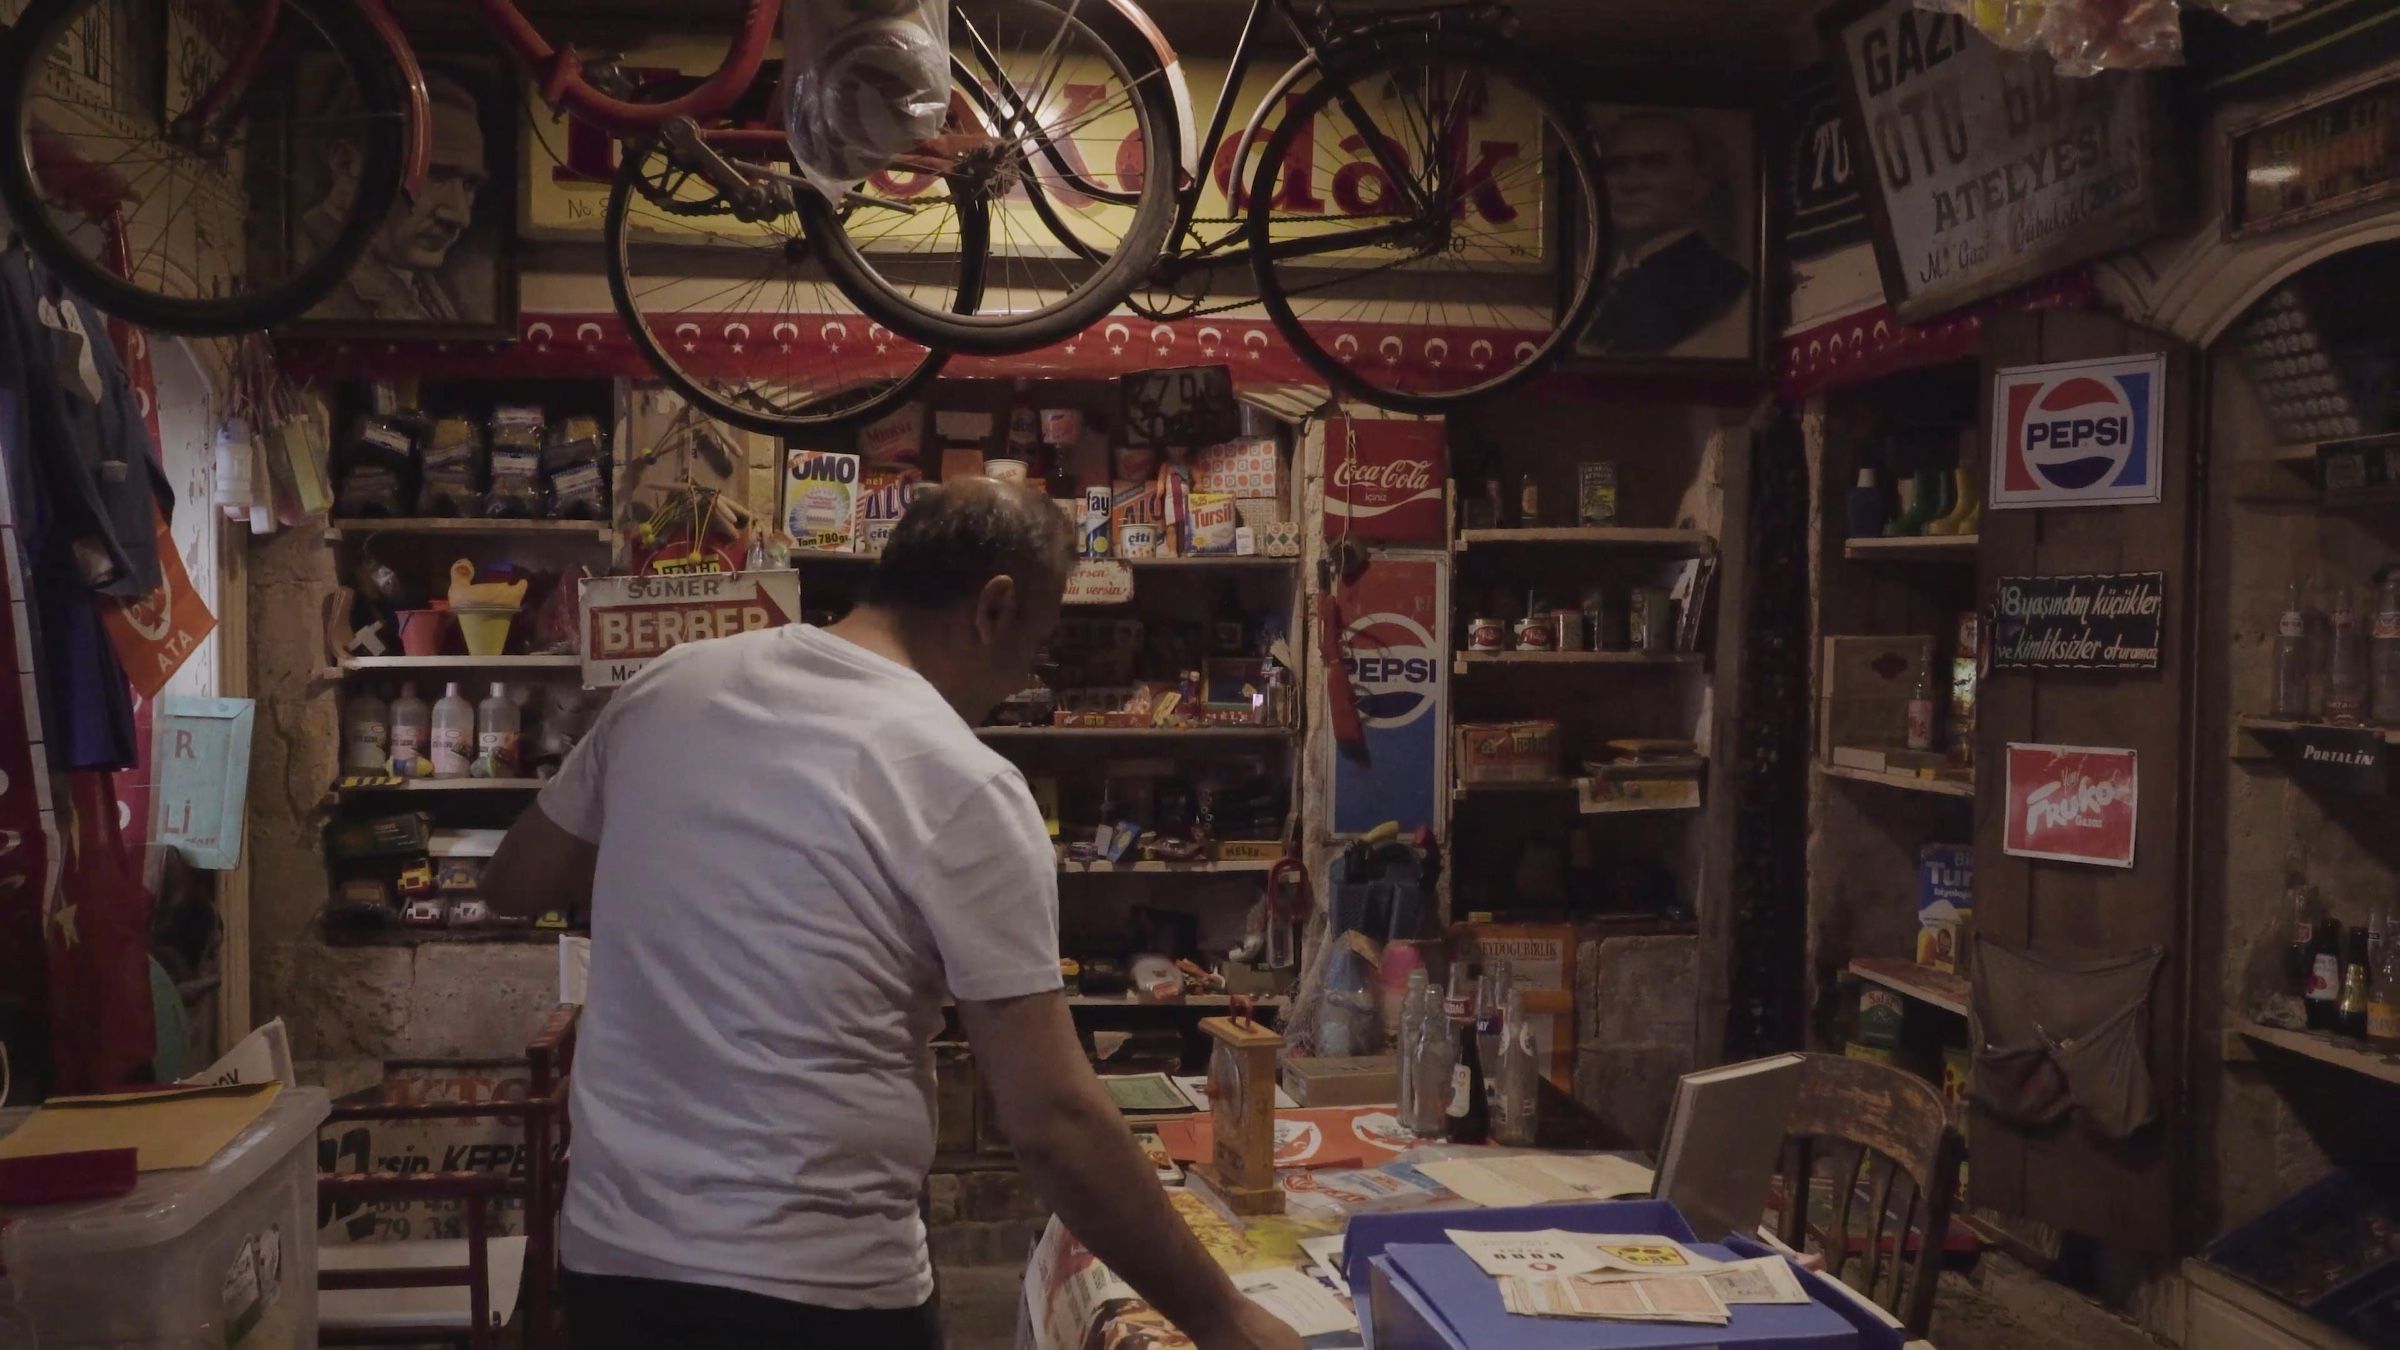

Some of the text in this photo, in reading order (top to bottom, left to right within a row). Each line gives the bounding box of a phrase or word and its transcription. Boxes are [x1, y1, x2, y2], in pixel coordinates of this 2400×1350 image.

[2026, 416, 2128, 451] PEPSI
[791, 455, 856, 484] OMO
[1333, 459, 1433, 489] Coca-Cola
[1087, 490, 1110, 517] fay
[1192, 502, 1232, 529] Tursil
[797, 537, 817, 547] Tam
[818, 533, 838, 545] 780
[627, 577, 721, 599] SÜMER
[2091, 583, 2161, 619] küçükler
[598, 605, 769, 652] BERBER
[157, 629, 193, 673] ATA
[2013, 627, 2103, 660] kimliksizler
[1342, 657, 1437, 683] PEPSI
[1926, 860, 1973, 887] Tur
[442, 1144, 528, 1178] KEPE
